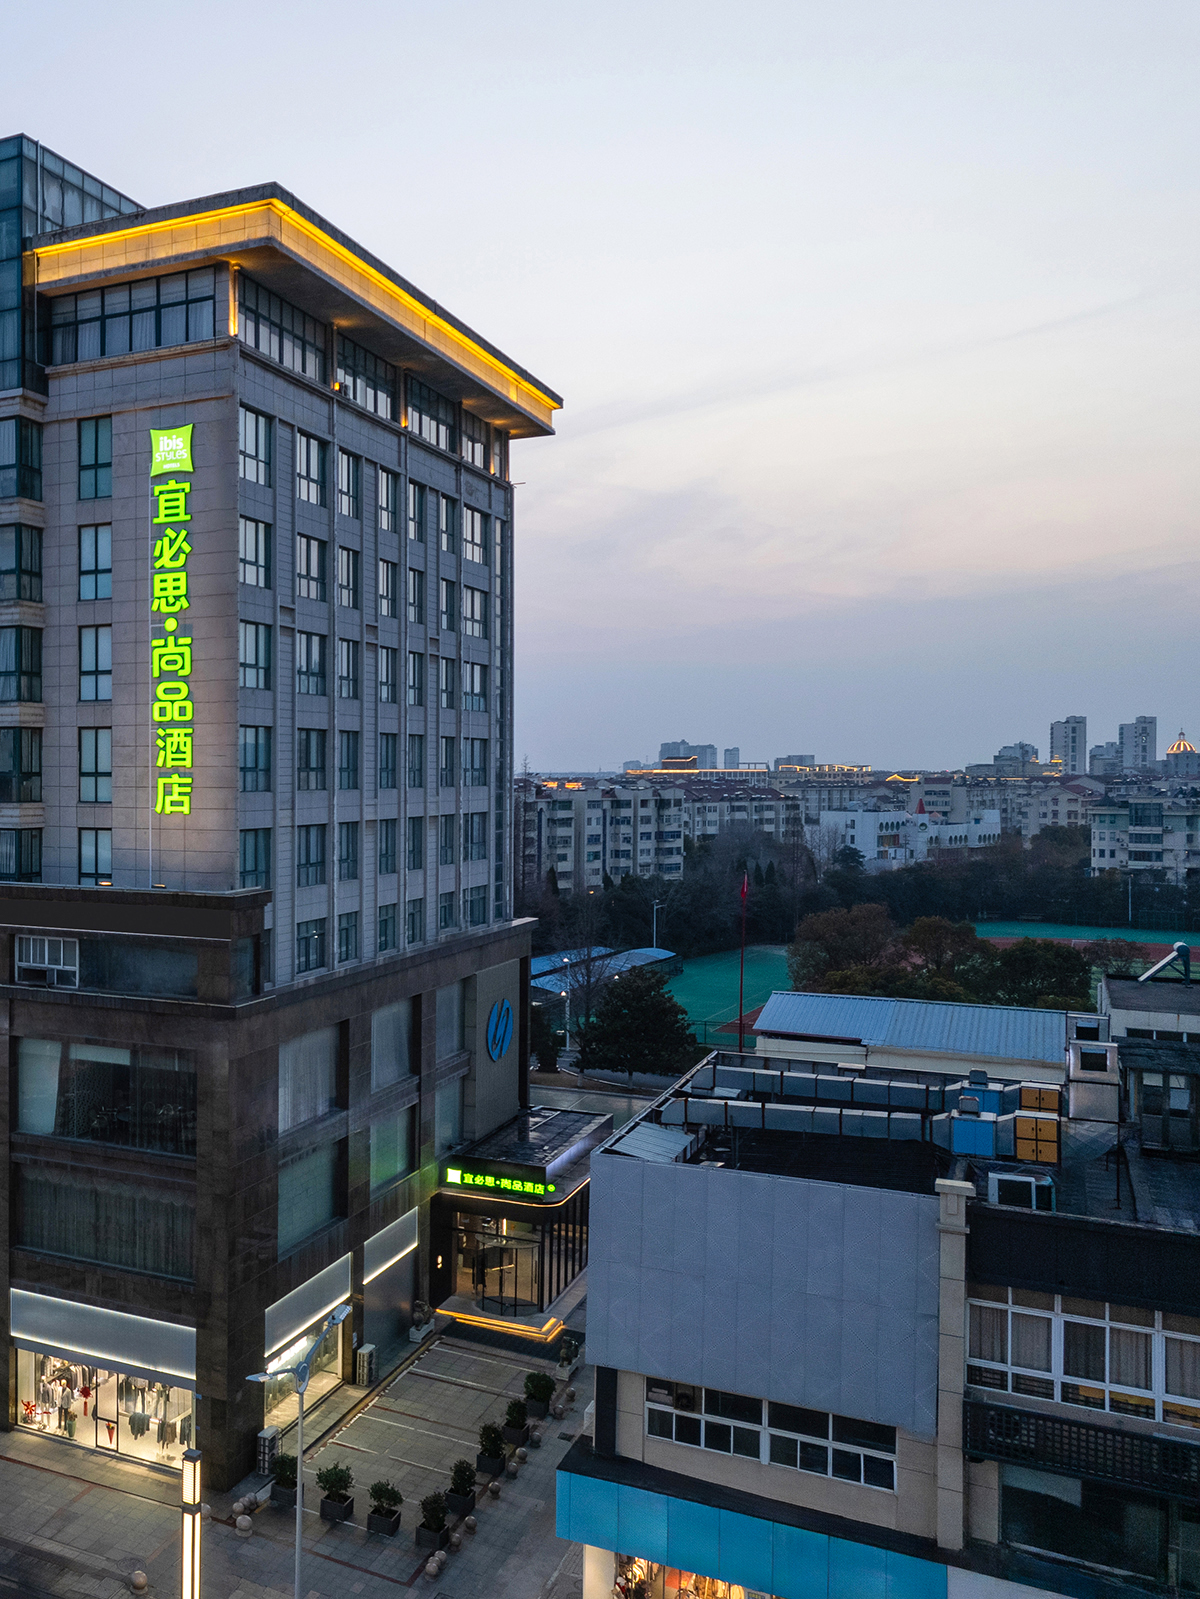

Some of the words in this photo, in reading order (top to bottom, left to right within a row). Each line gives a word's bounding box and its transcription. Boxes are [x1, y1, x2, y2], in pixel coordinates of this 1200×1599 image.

[159, 434, 184, 451] ibis
[150, 479, 194, 815] 宜必思·尚品酒店
